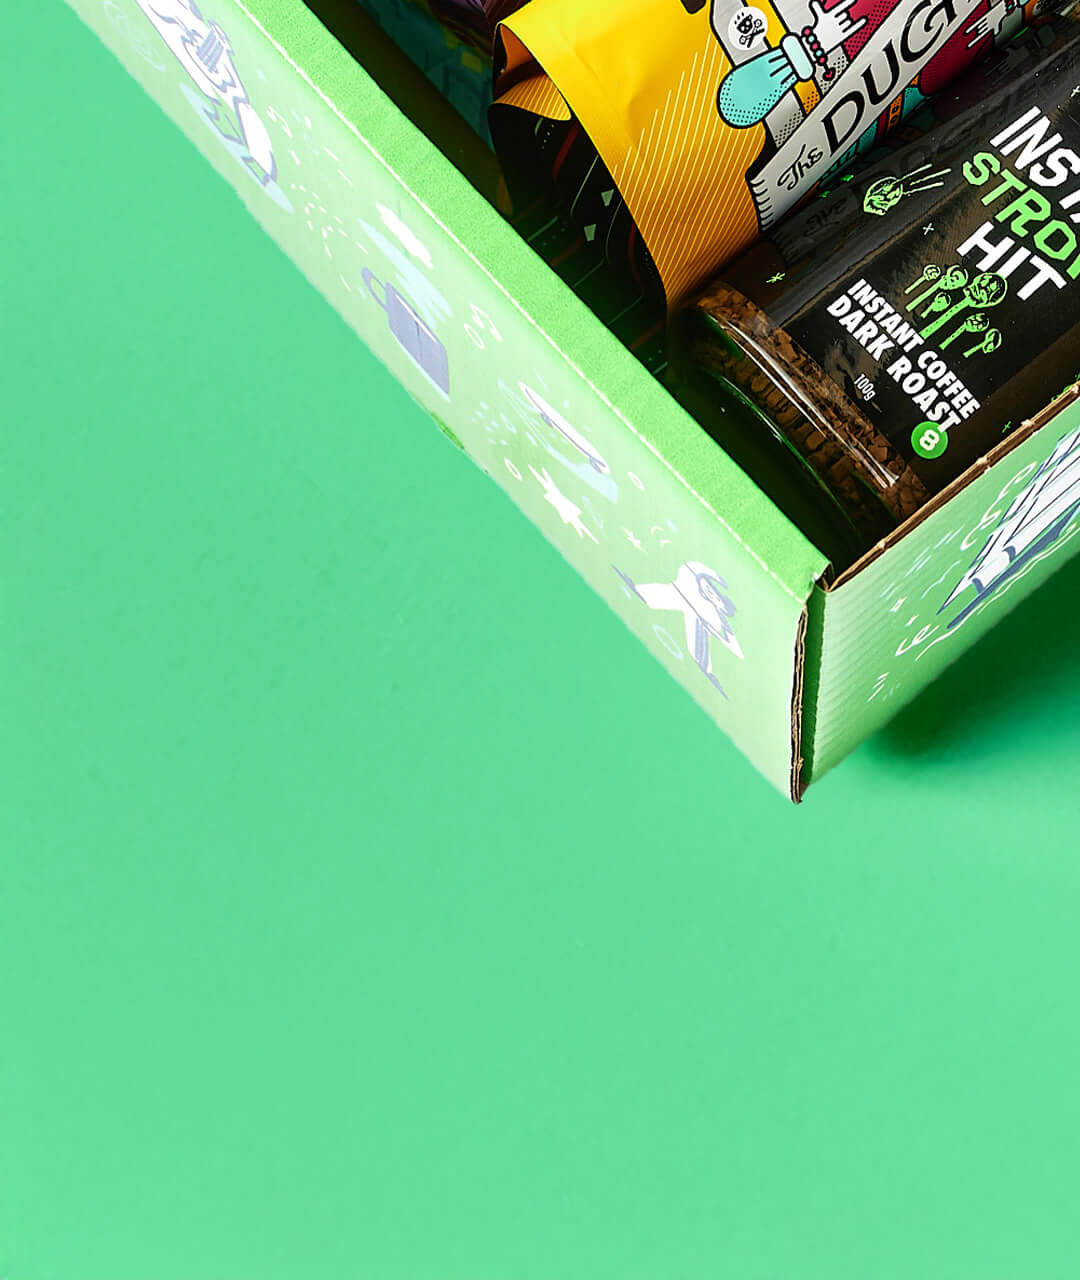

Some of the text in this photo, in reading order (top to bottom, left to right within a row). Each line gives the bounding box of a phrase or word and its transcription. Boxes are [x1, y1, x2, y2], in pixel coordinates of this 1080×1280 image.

[956, 221, 1067, 301] HIT
[826, 300, 962, 432] DARK ROAST
[848, 278, 982, 418] INSTANT COFFEE
[853, 373, 875, 400] 100g
[919, 430, 937, 451] 8
